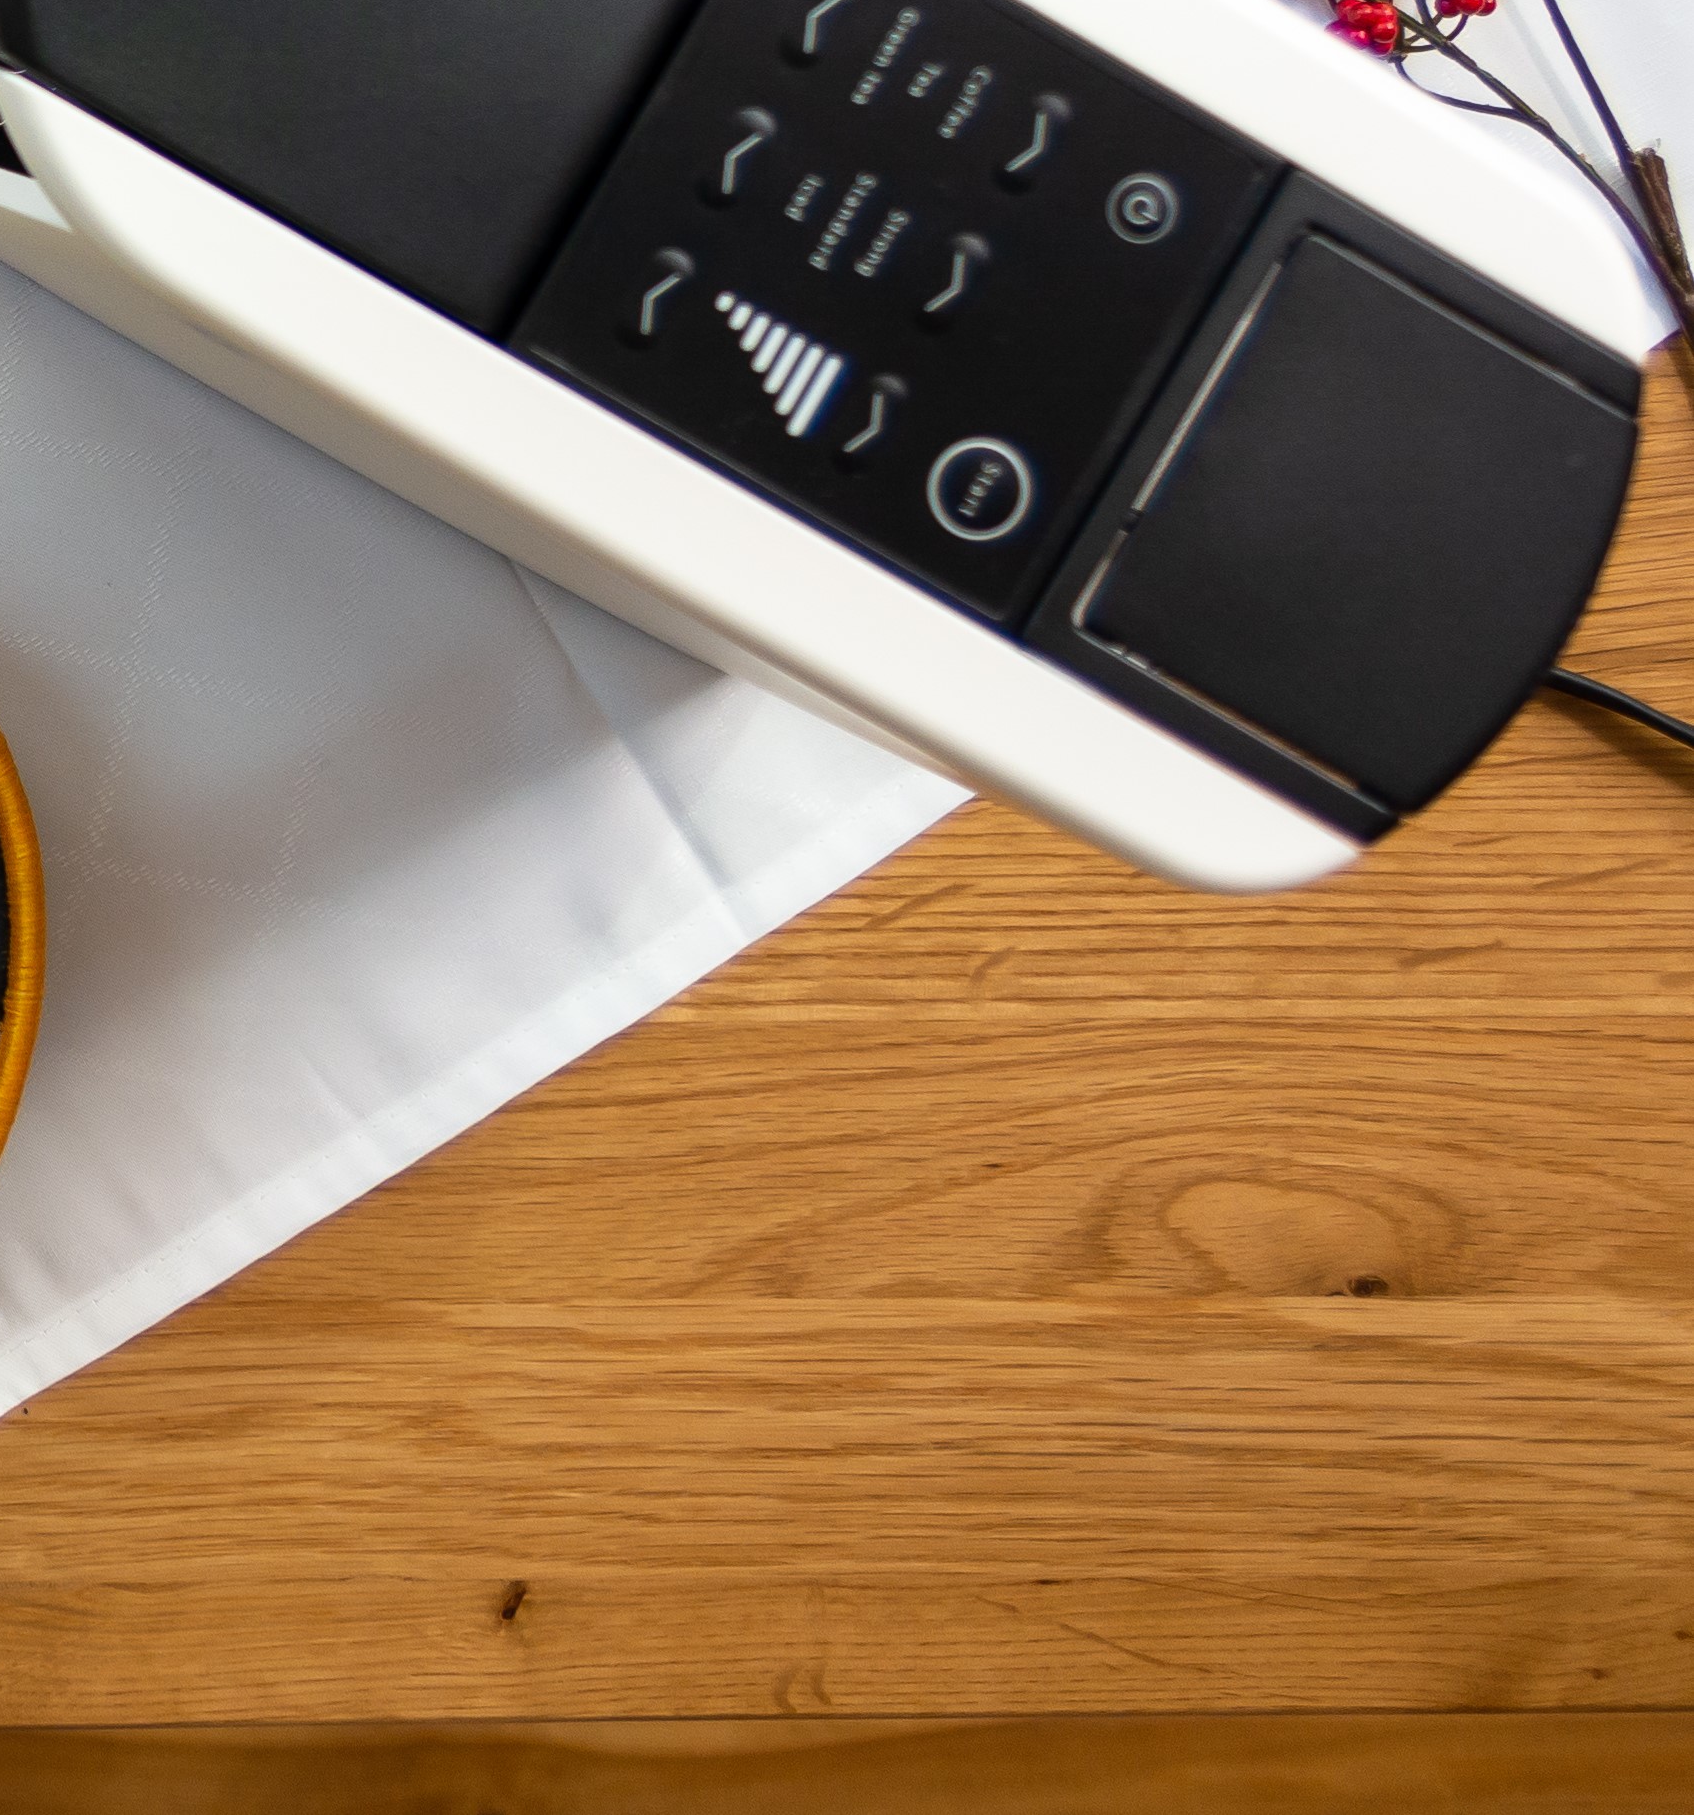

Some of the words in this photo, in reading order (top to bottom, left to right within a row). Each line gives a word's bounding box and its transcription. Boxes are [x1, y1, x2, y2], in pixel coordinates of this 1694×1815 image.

[872, 6, 921, 68] Green
[850, 70, 883, 105] tea
[908, 62, 946, 98] Tea
[937, 65, 993, 139] Coffee
[784, 173, 825, 222] Iced
[808, 173, 879, 271] Standard
[854, 207, 911, 278] Strong
[958, 461, 1004, 517] Start
